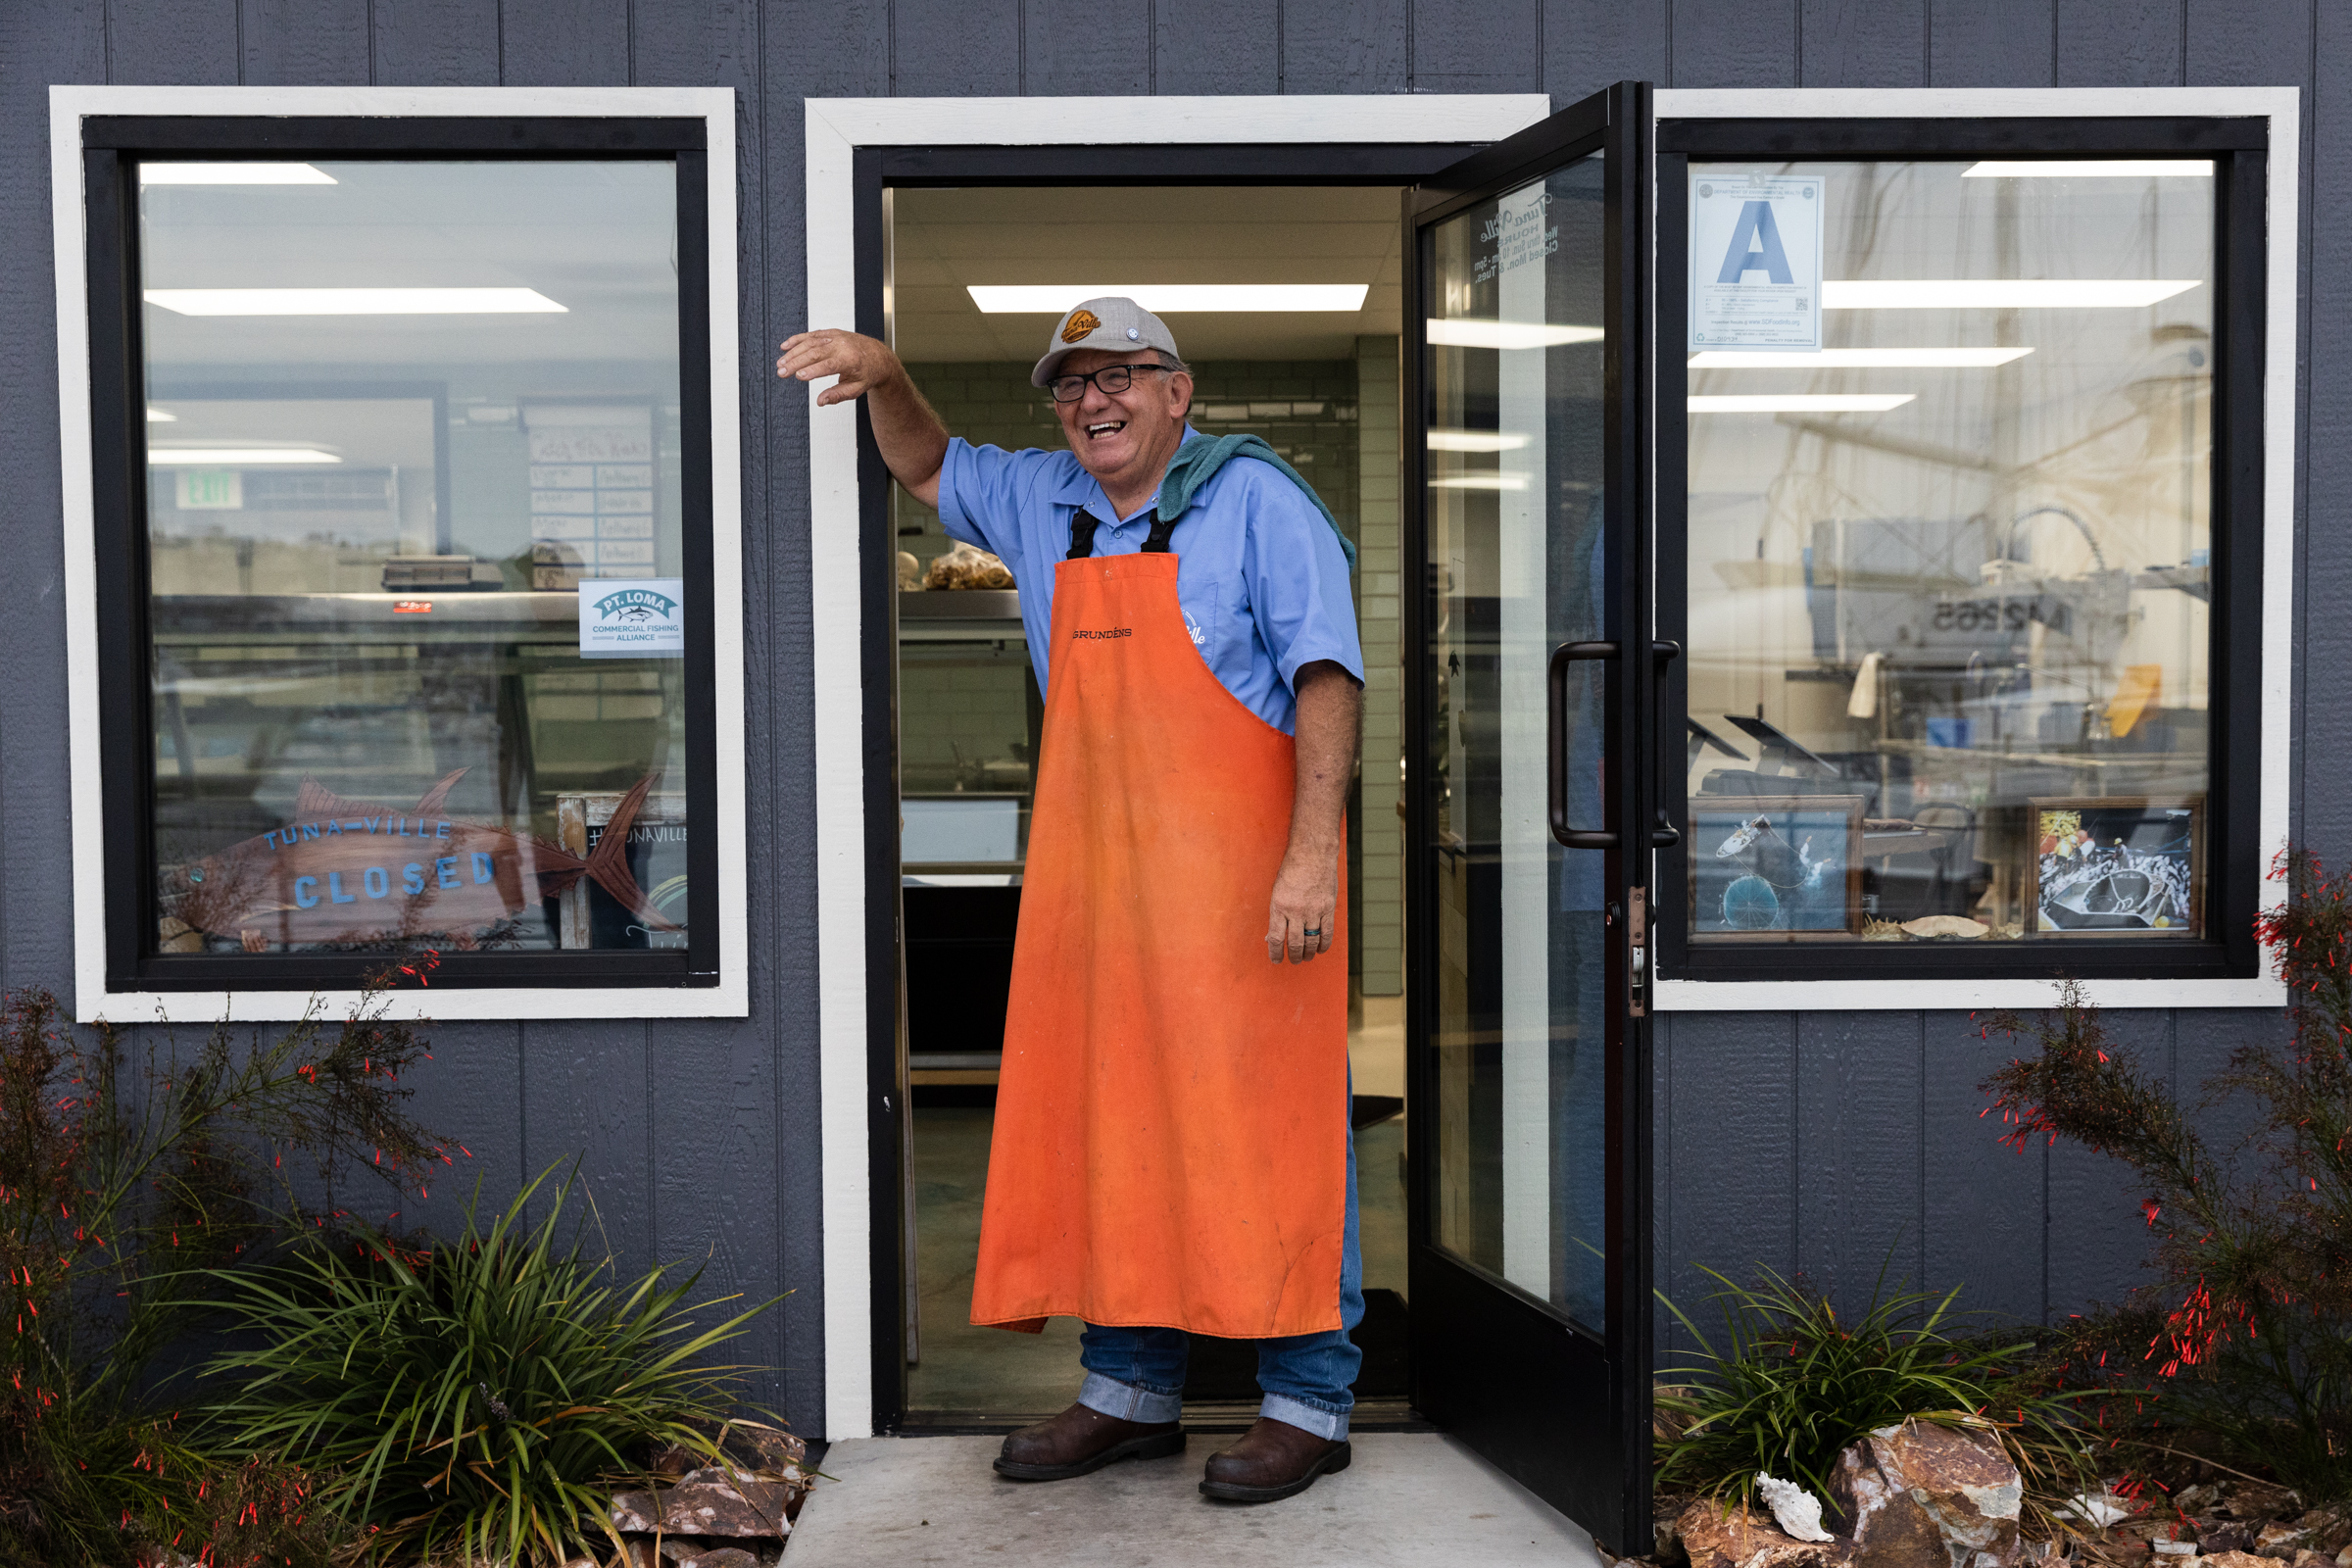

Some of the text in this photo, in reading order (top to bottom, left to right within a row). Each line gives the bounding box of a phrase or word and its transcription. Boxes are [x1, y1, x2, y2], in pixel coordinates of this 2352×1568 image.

[1717, 201, 1794, 284] A
[603, 592, 665, 612] PT. LOMA
[616, 633, 656, 642] ALLIANCE
[294, 851, 495, 909] CLOSED
